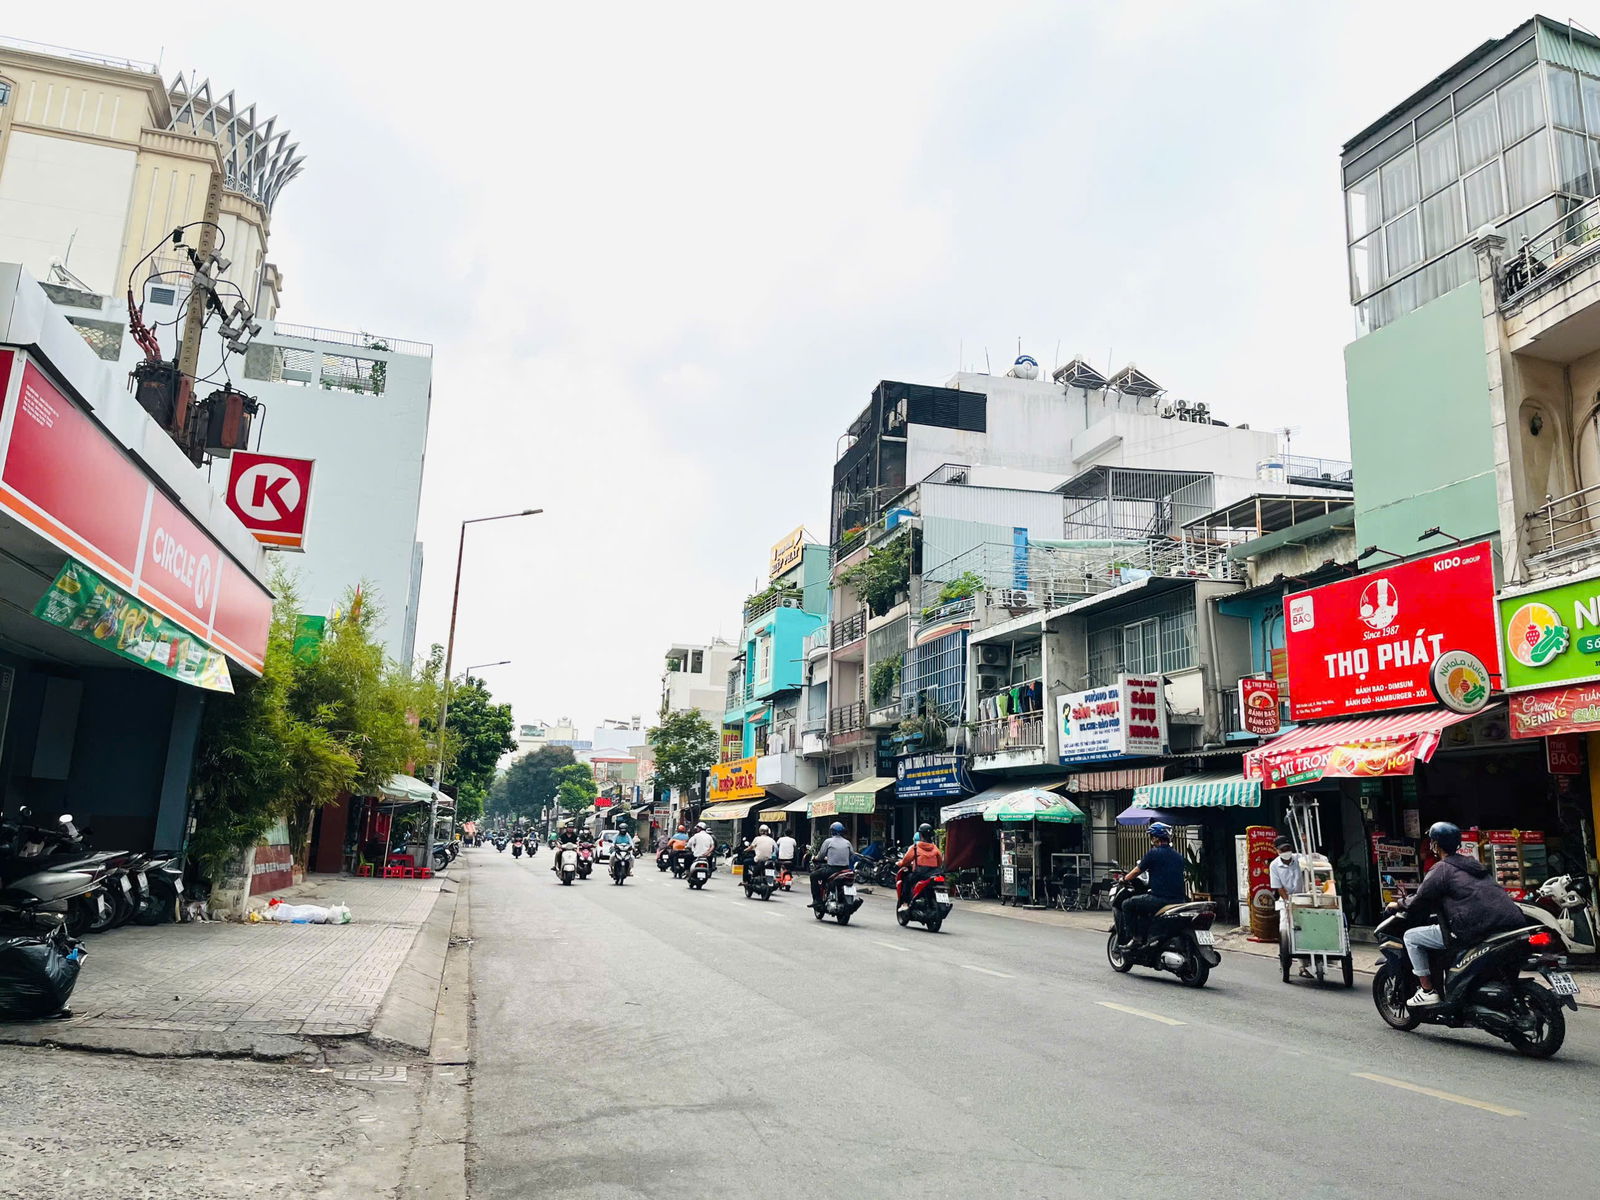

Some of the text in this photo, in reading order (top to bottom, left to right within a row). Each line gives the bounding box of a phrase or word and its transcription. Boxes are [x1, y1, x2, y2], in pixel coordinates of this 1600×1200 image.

[152, 527, 196, 589] CIRCLE
[1433, 554, 1481, 573] KIDO GROUP
[1574, 595, 1600, 630] N
[1362, 624, 1400, 641] Since 1987
[1323, 628, 1444, 681] THỌ PHÁT
[1355, 680, 1414, 695] BÁNH BAO DIMSUM
[1345, 697, 1361, 707] BÁNH
[1375, 691, 1413, 703] HAMBURGER
[1456, 946, 1490, 969] VARIO
